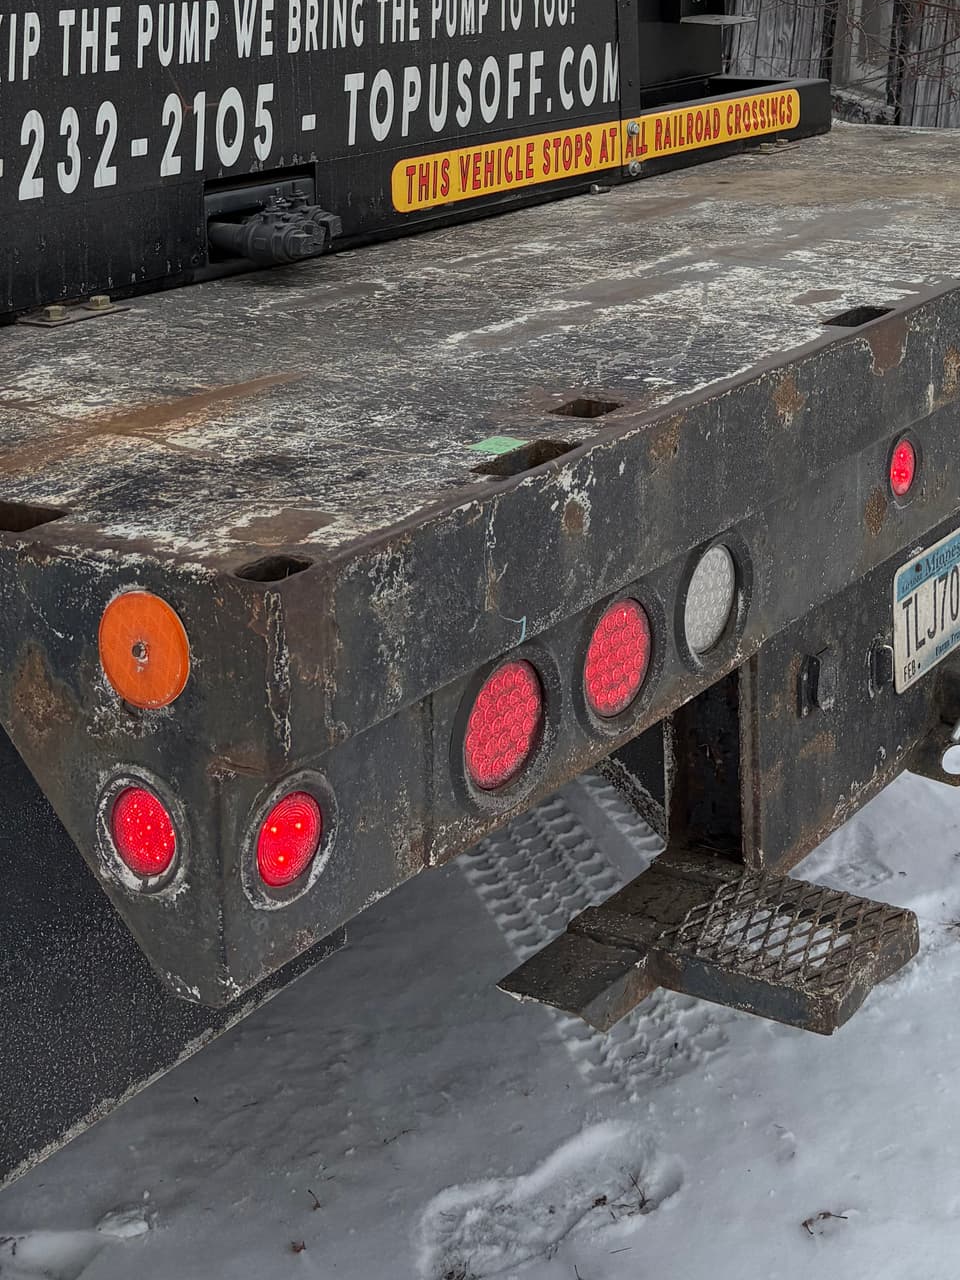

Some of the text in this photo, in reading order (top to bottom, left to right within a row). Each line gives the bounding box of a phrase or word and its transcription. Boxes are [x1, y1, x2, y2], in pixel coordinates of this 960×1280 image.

[0, 12, 41, 82] IP
[59, 6, 121, 77] THE
[137, 0, 220, 68] PUMP
[0, 83, 274, 201] 232-2105
[344, 42, 620, 146] TOPUSOFF.COM
[406, 94, 793, 204] THIS VEHICLE STOPS AT ALL RAILROAD CROSSINGS
[903, 660, 916, 682] FEB
